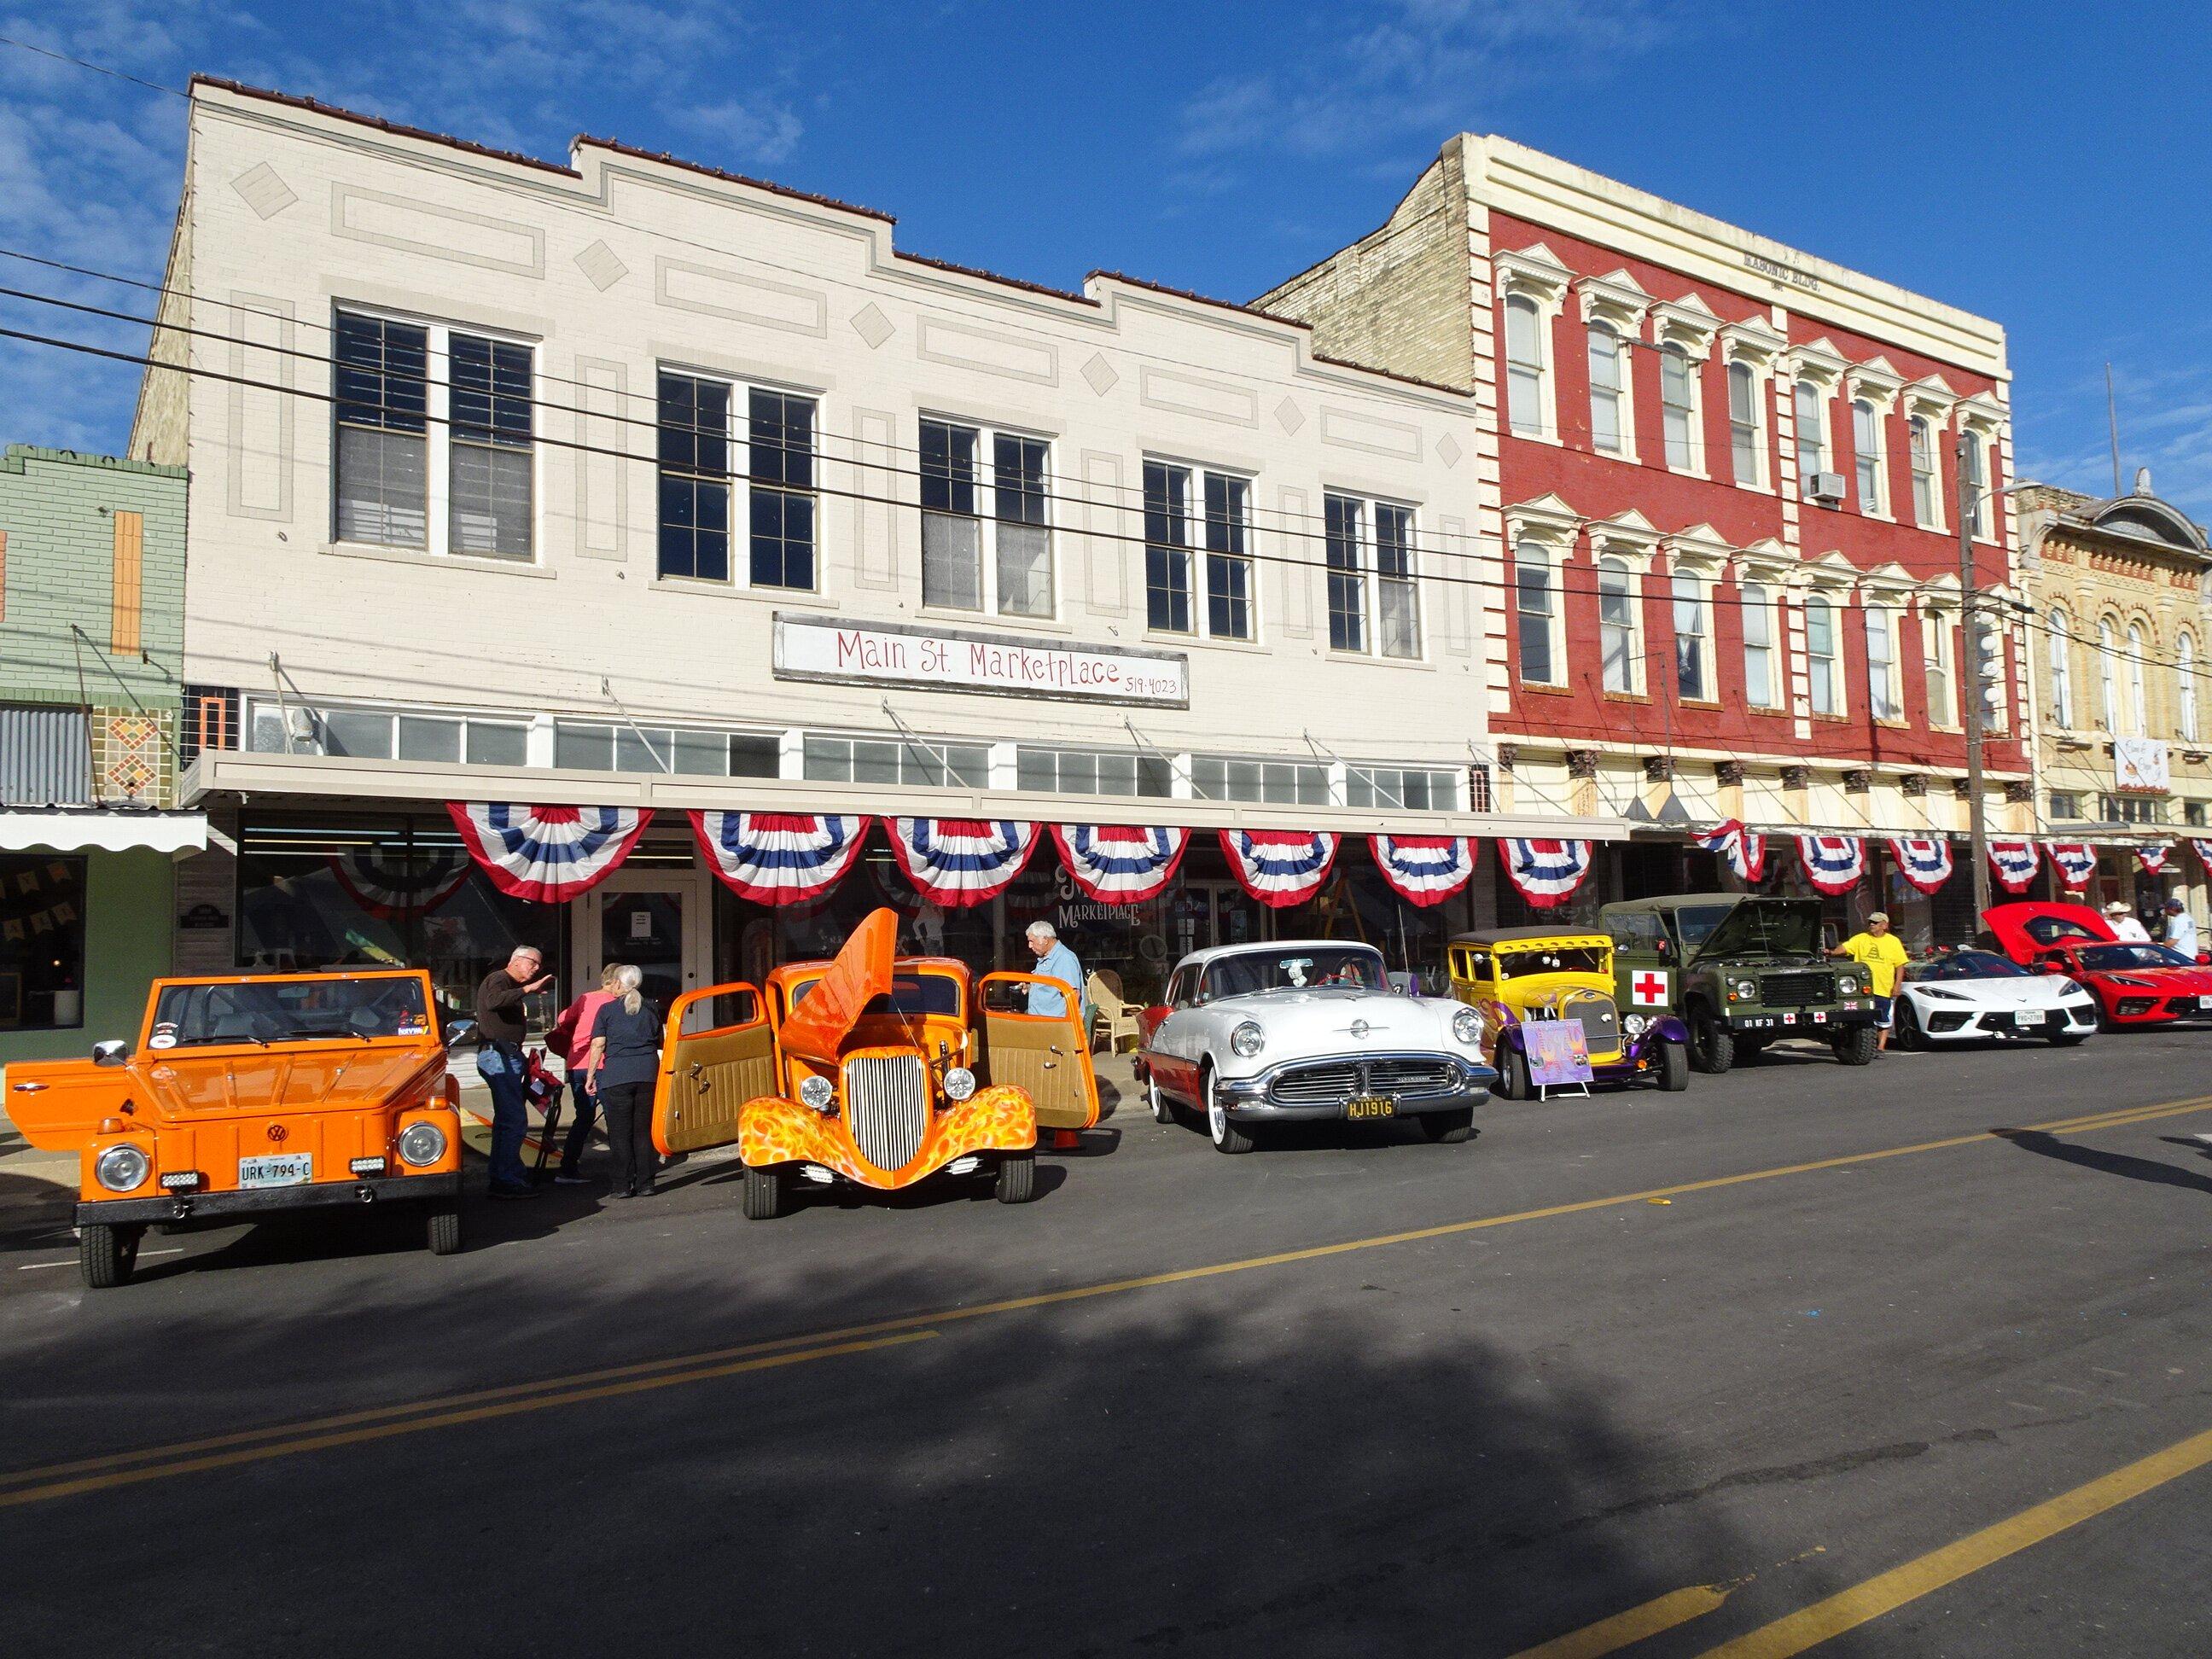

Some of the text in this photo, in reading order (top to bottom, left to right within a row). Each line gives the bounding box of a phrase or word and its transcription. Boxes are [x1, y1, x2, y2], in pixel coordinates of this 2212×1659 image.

[1743, 253, 1789, 280] MASONIC
[837, 631, 1121, 686] Main St. Marketplace
[1350, 1101, 1392, 1116] HJ1916
[242, 1161, 310, 1180] URK-794-C
